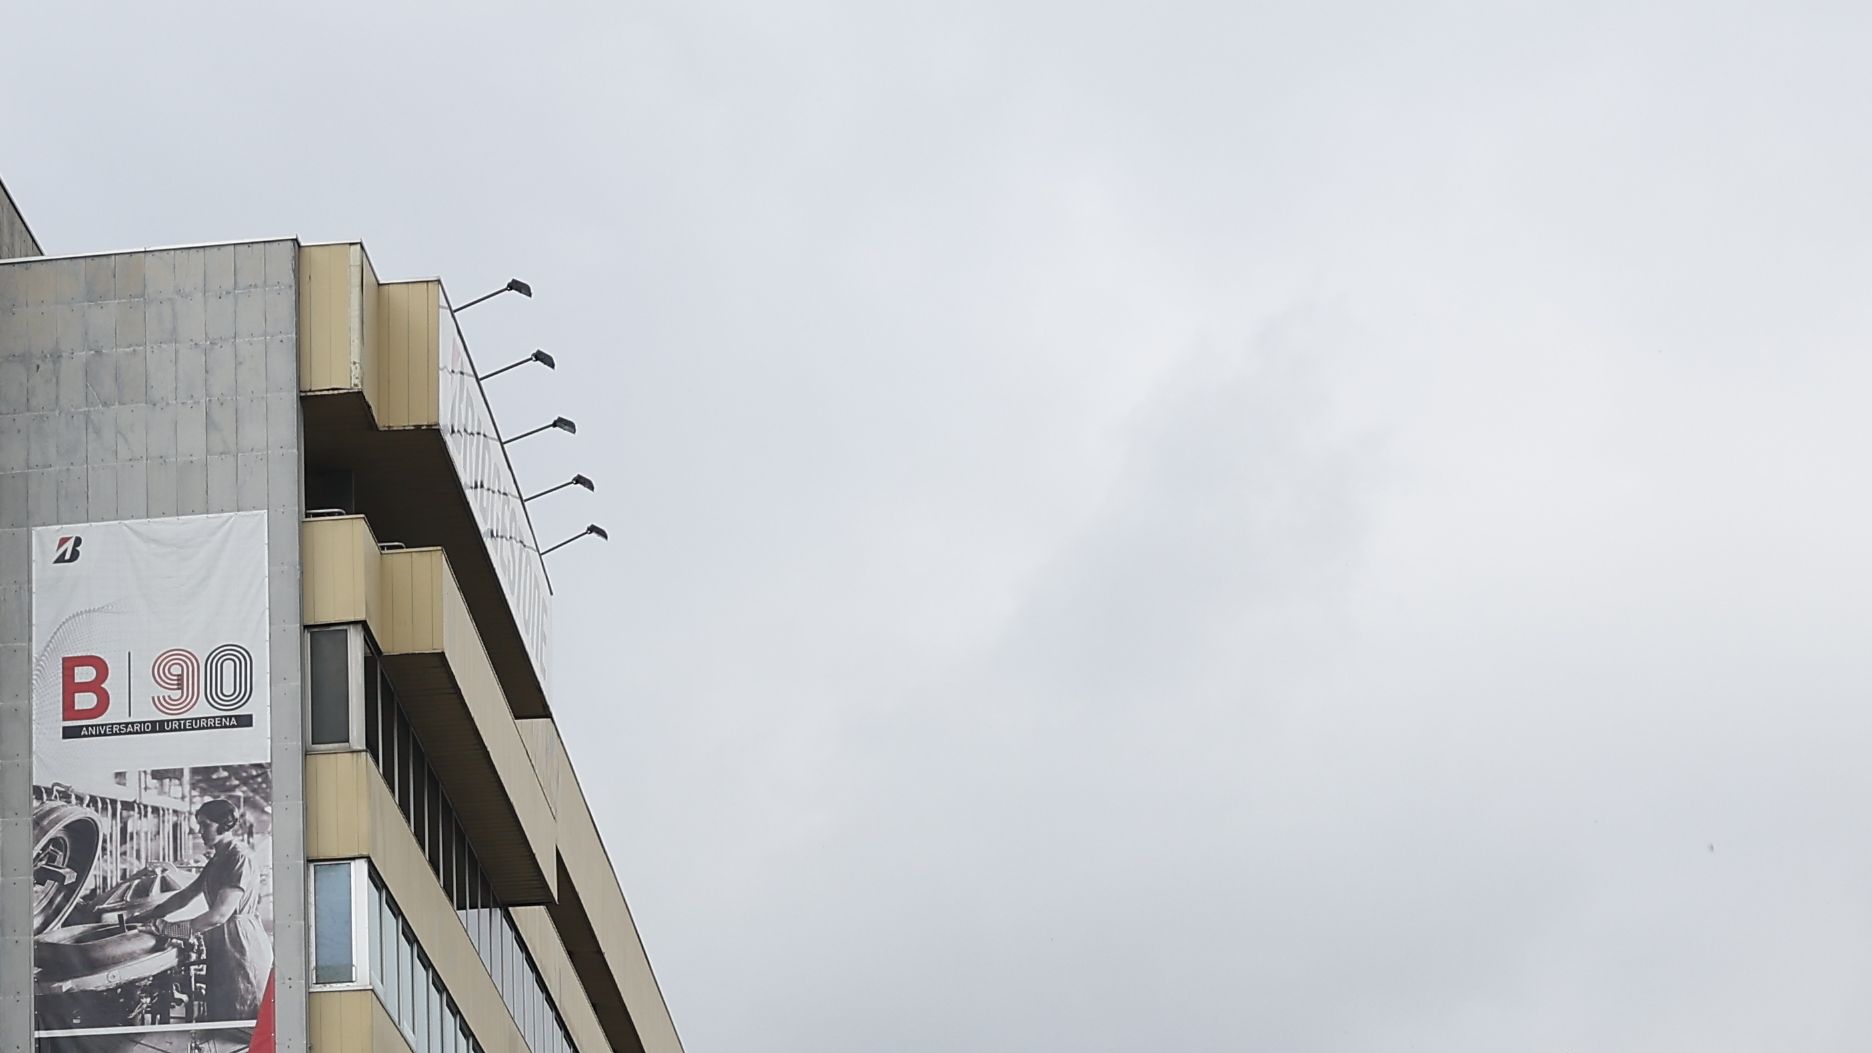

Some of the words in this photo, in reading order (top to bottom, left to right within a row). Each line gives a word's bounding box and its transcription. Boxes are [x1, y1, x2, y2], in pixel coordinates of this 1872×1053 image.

[61, 654, 111, 722] B
[151, 643, 254, 716] 90
[80, 721, 152, 737] ANIVERSARIO
[164, 716, 238, 731] URTEURRENA
